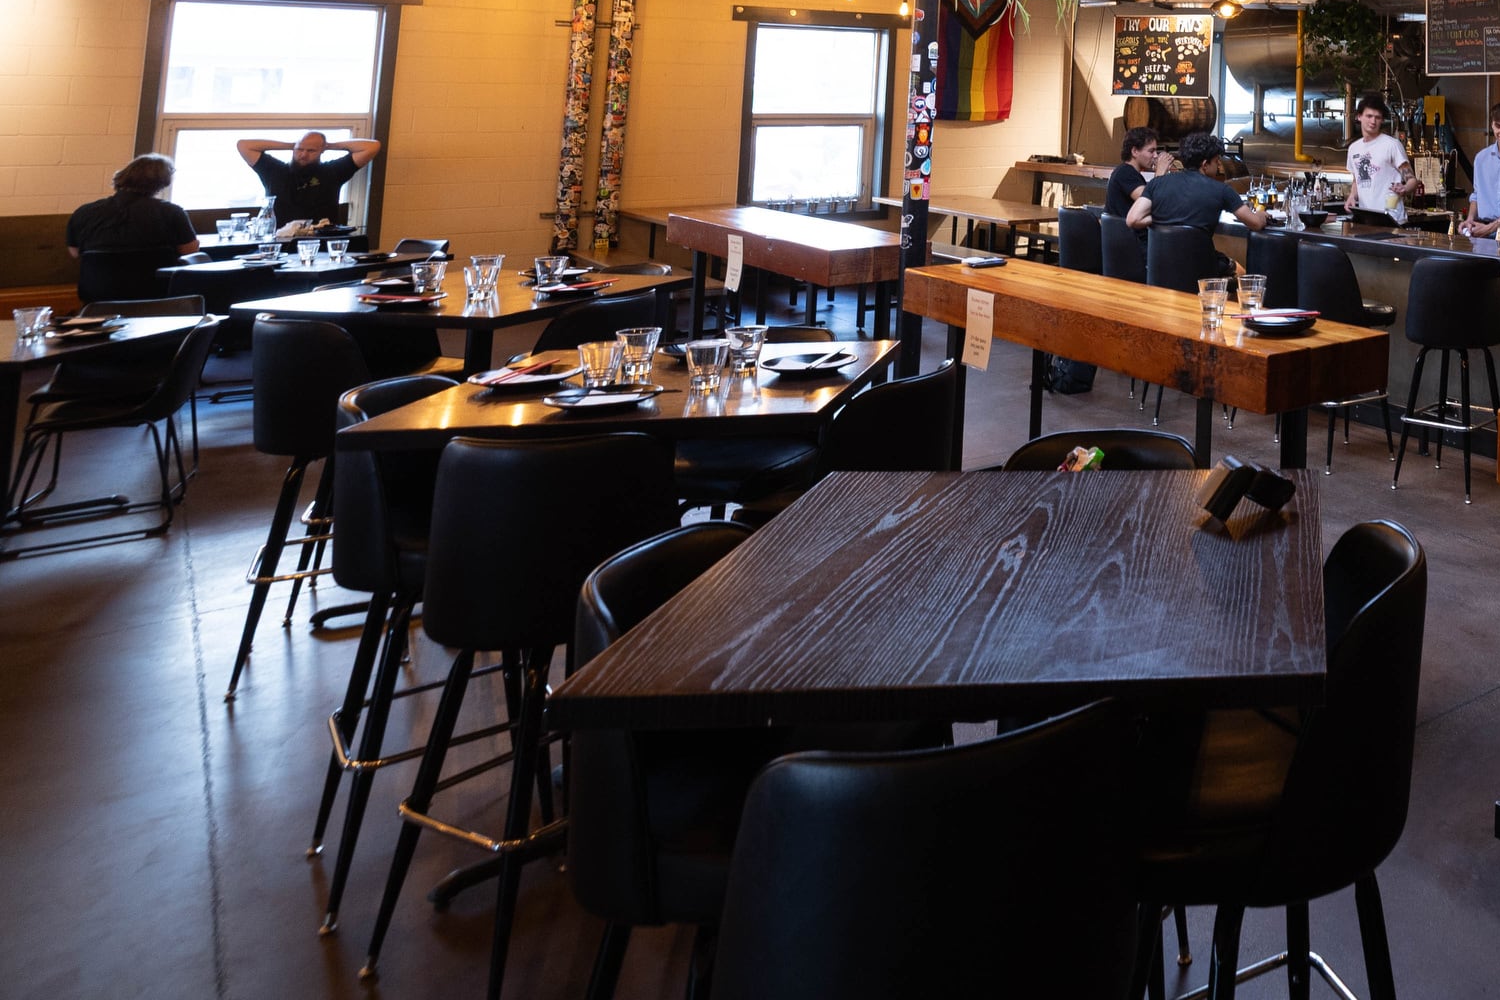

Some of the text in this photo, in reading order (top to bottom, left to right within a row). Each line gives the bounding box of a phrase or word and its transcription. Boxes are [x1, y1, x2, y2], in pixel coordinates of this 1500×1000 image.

[1123, 17, 1202, 32] TRY OUR FAVS
[1144, 64, 1161, 73] BEEF
